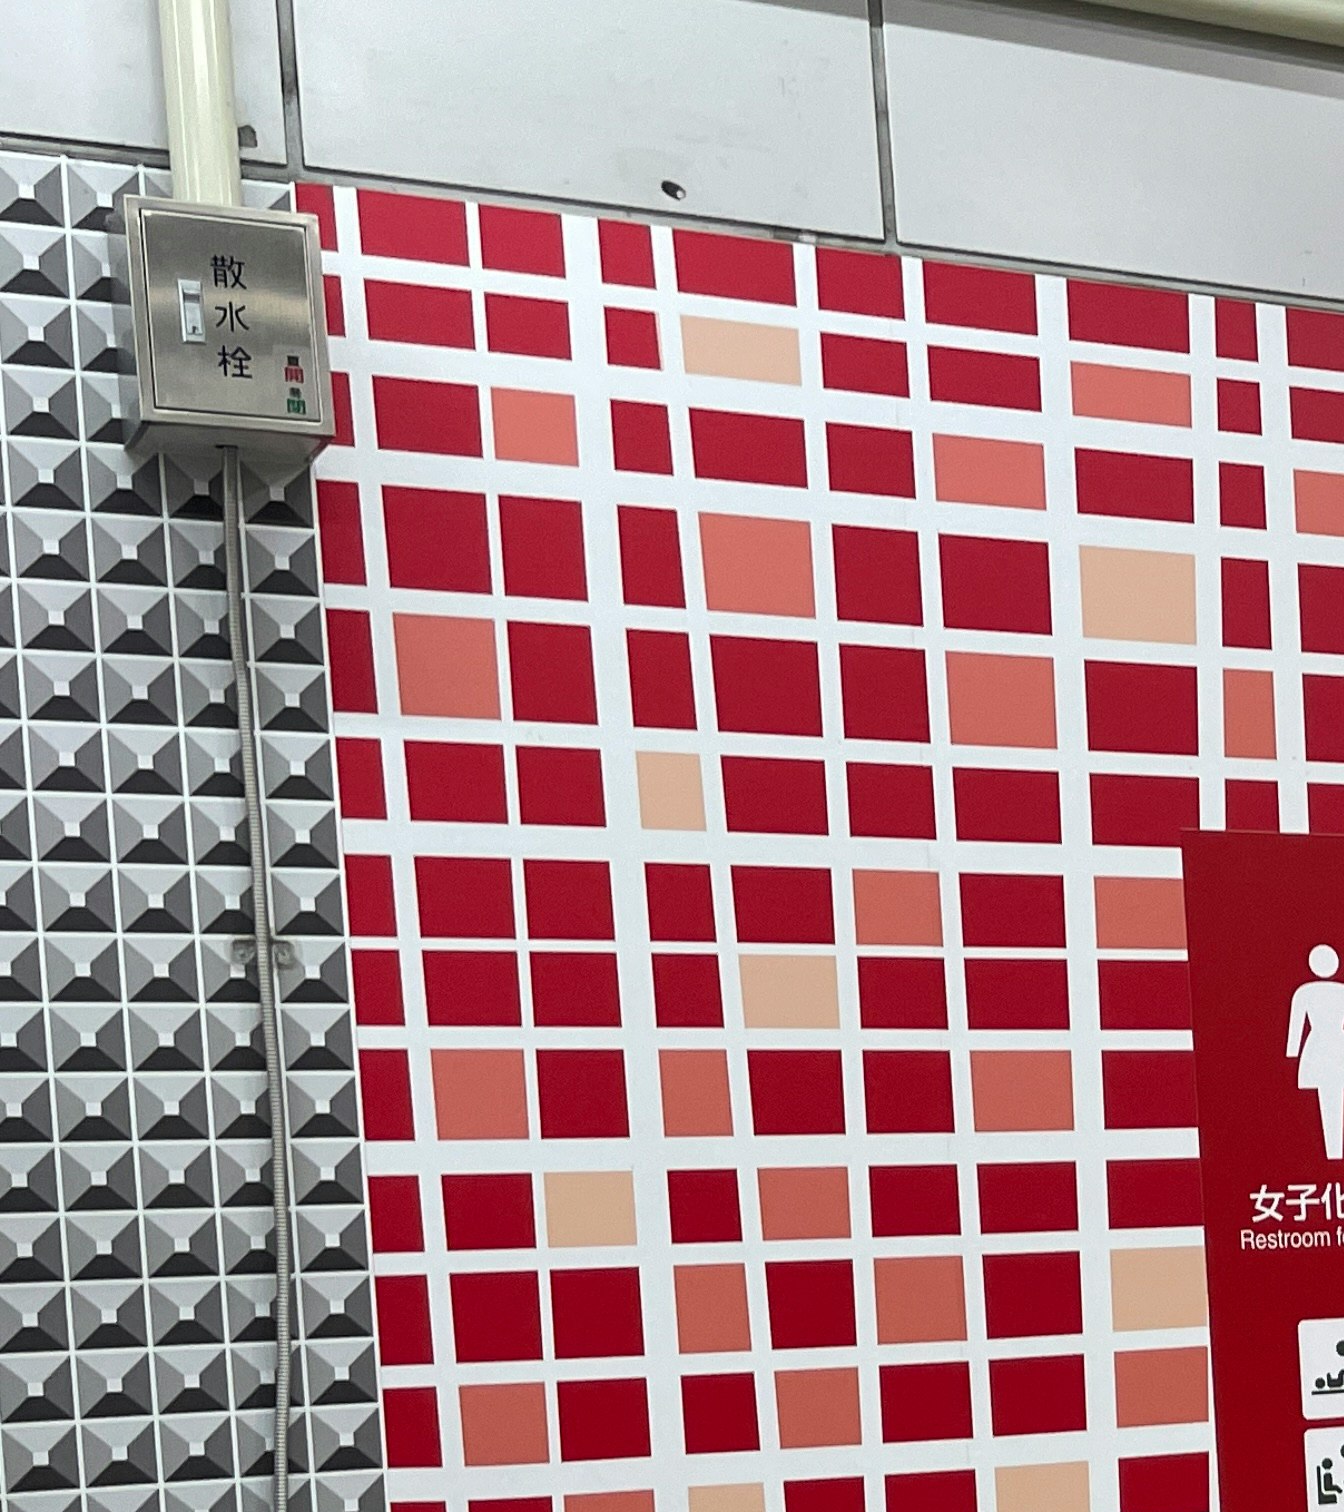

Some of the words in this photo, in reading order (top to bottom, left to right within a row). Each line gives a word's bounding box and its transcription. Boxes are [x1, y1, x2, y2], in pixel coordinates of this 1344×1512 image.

[210, 253, 253, 381] 散水栓
[1240, 1228, 1331, 1250] Restroom
